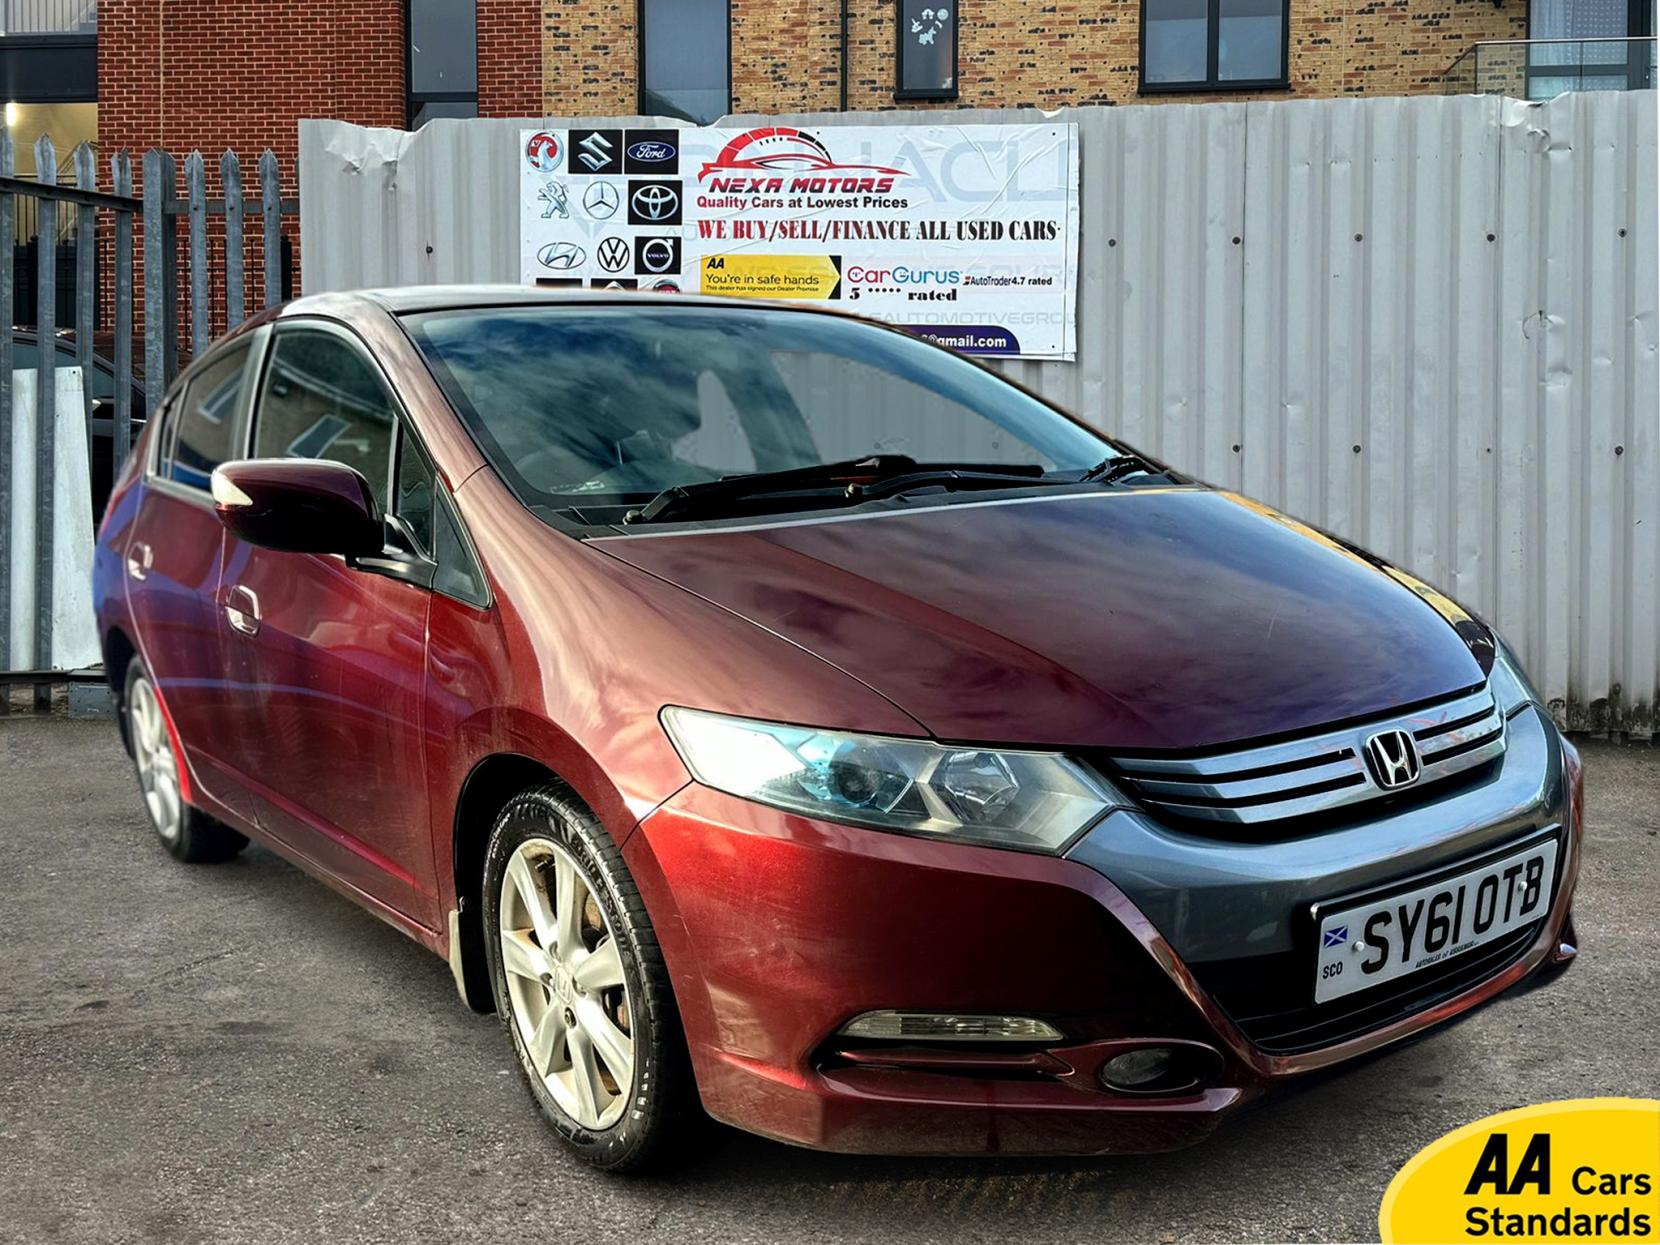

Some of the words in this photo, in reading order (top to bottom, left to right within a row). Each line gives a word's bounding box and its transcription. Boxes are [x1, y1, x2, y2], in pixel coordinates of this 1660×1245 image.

[636, 144, 666, 159] Ford
[708, 178, 784, 194] NEXA
[789, 177, 895, 194] MOTORS
[697, 196, 749, 211] Quality
[752, 196, 784, 208] Cars
[788, 197, 803, 208] at
[807, 196, 858, 208] Lowest
[863, 196, 908, 209] Prices
[698, 219, 727, 240] WE
[916, 220, 951, 240] ALL
[956, 220, 1004, 240] USED
[1009, 220, 1057, 240] CARS
[706, 257, 725, 270] AA
[705, 274, 741, 285] You're
[744, 274, 754, 284] in
[757, 274, 782, 285] safe
[784, 274, 820, 285] hands
[847, 265, 960, 284] CarGurus
[1028, 276, 1053, 286] rated
[747, 285, 766, 293] signed
[849, 287, 860, 300] 5
[908, 288, 958, 301] rated
[1473, 855, 1545, 935] OTB
[1322, 961, 1343, 980] SCO
